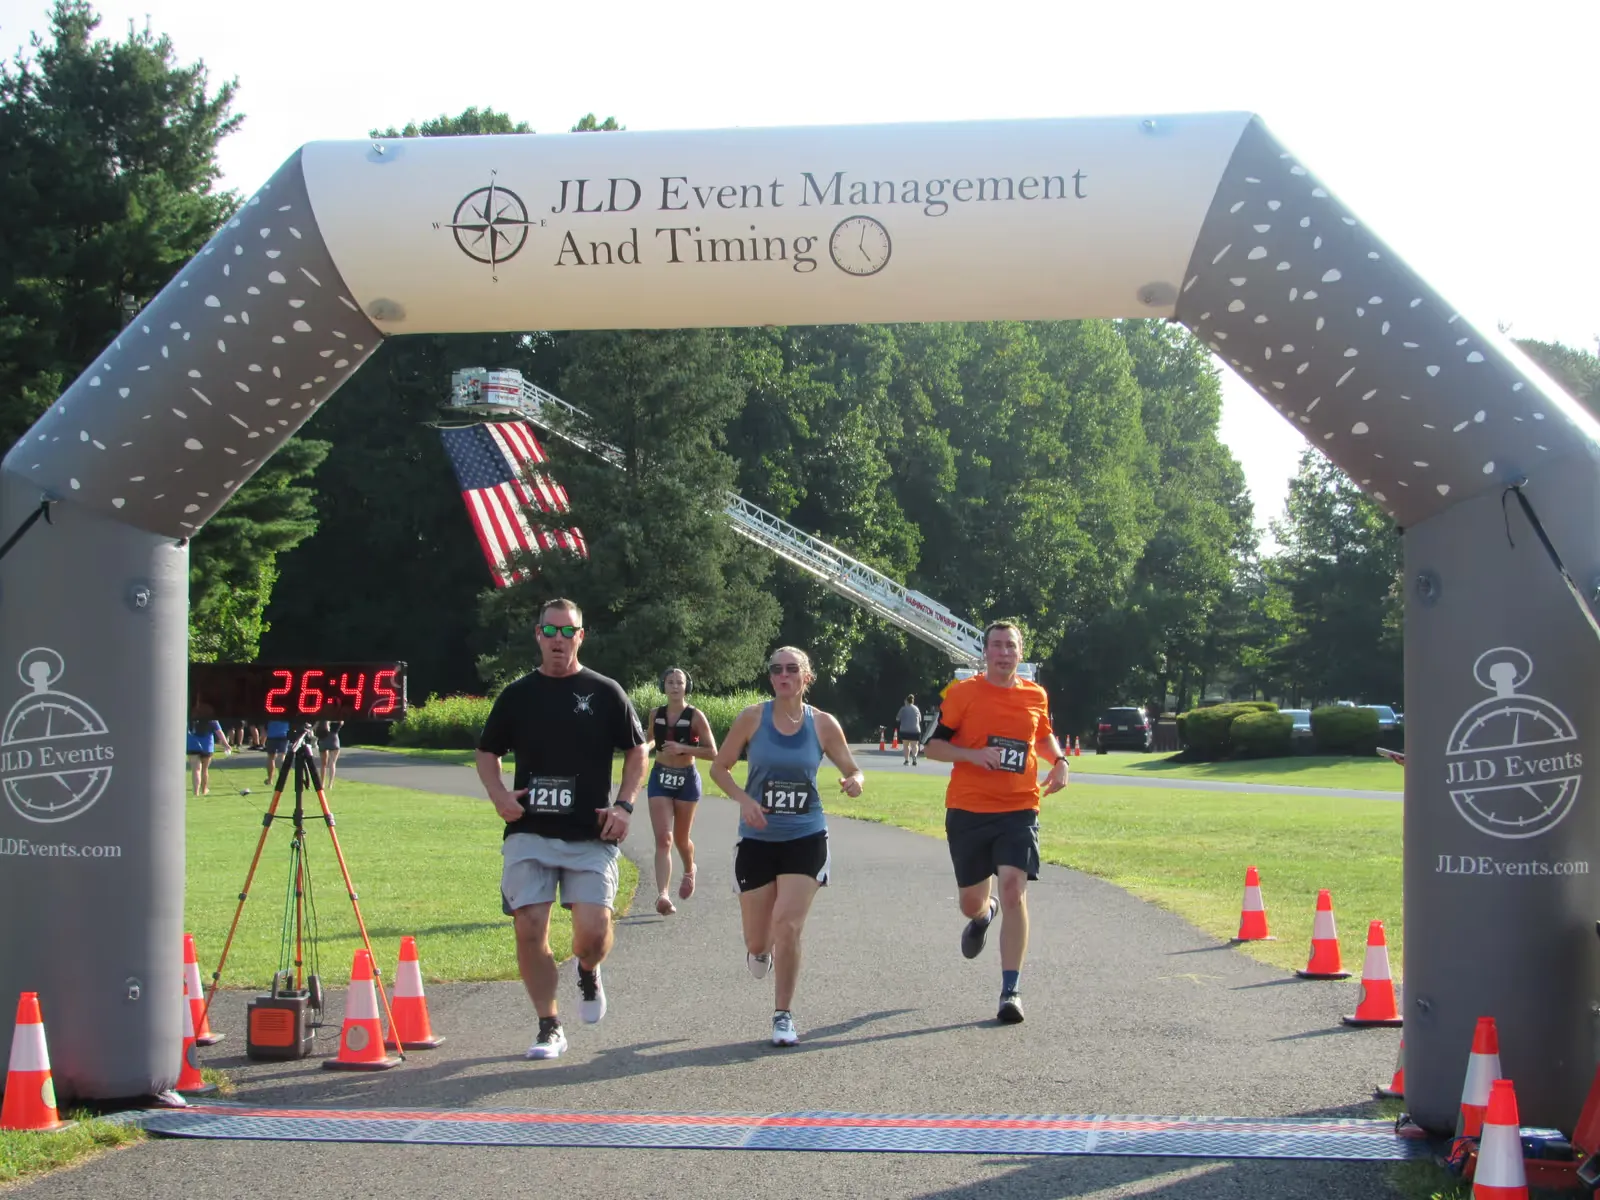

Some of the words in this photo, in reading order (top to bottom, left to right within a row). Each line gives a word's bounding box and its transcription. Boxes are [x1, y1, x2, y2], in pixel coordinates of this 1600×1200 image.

[490, 168, 498, 176] N
[551, 178, 642, 214] JLD
[657, 176, 785, 211] Event
[799, 168, 1088, 217] Management
[431, 222, 441, 230] W
[540, 219, 547, 227] E
[553, 228, 642, 267] And
[655, 224, 818, 273] Timing
[492, 275, 499, 283] S
[264, 670, 396, 713] 26:45
[0, 749, 33, 773] JLD
[38, 744, 115, 767] Events
[1445, 758, 1497, 784] JLD
[1504, 751, 1584, 778] Events
[659, 772, 685, 787] 1213
[528, 787, 572, 807] 1216
[764, 790, 809, 809] 1217
[1435, 854, 1590, 876] JLDEvents.com
